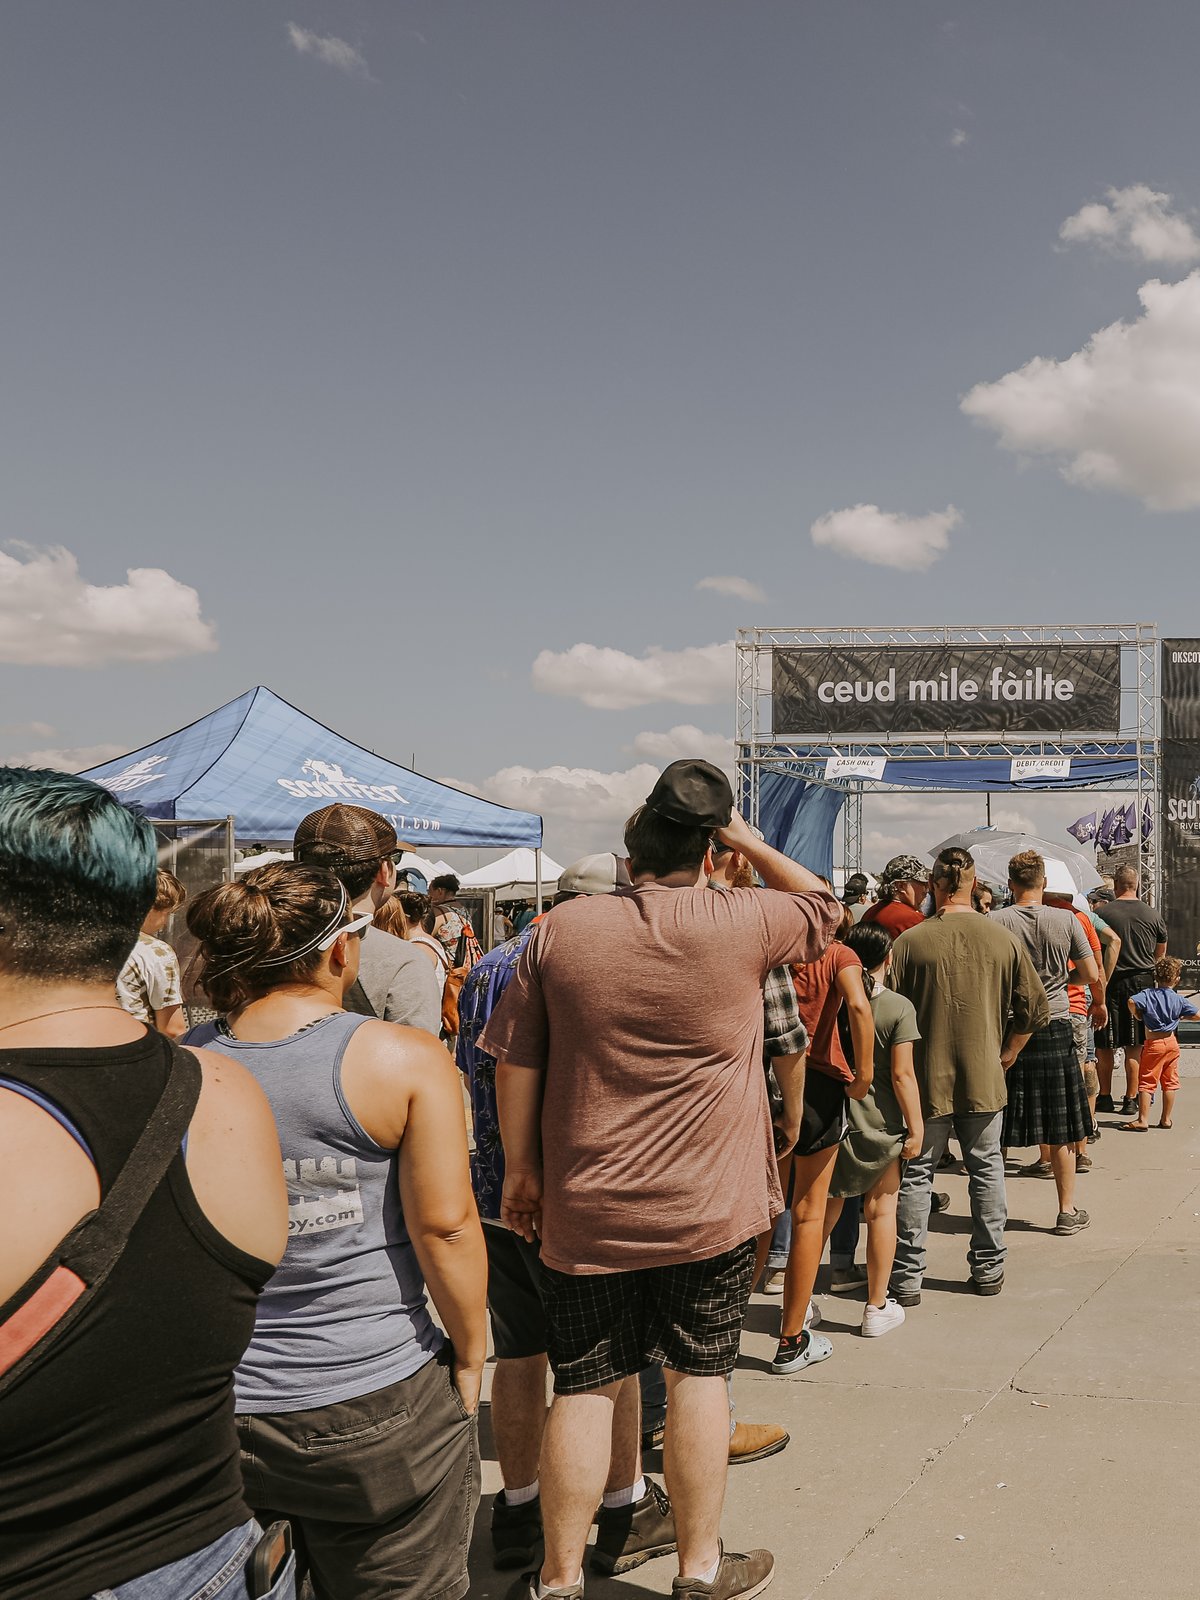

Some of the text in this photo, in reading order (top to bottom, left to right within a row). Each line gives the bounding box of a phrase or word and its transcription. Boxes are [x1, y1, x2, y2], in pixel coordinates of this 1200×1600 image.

[817, 666, 1075, 703] ceud mìle fàilte
[856, 759, 876, 767] ONLY
[1016, 759, 1065, 768] DEBIT/CREDIT
[276, 778, 410, 804] SCOTFEST
